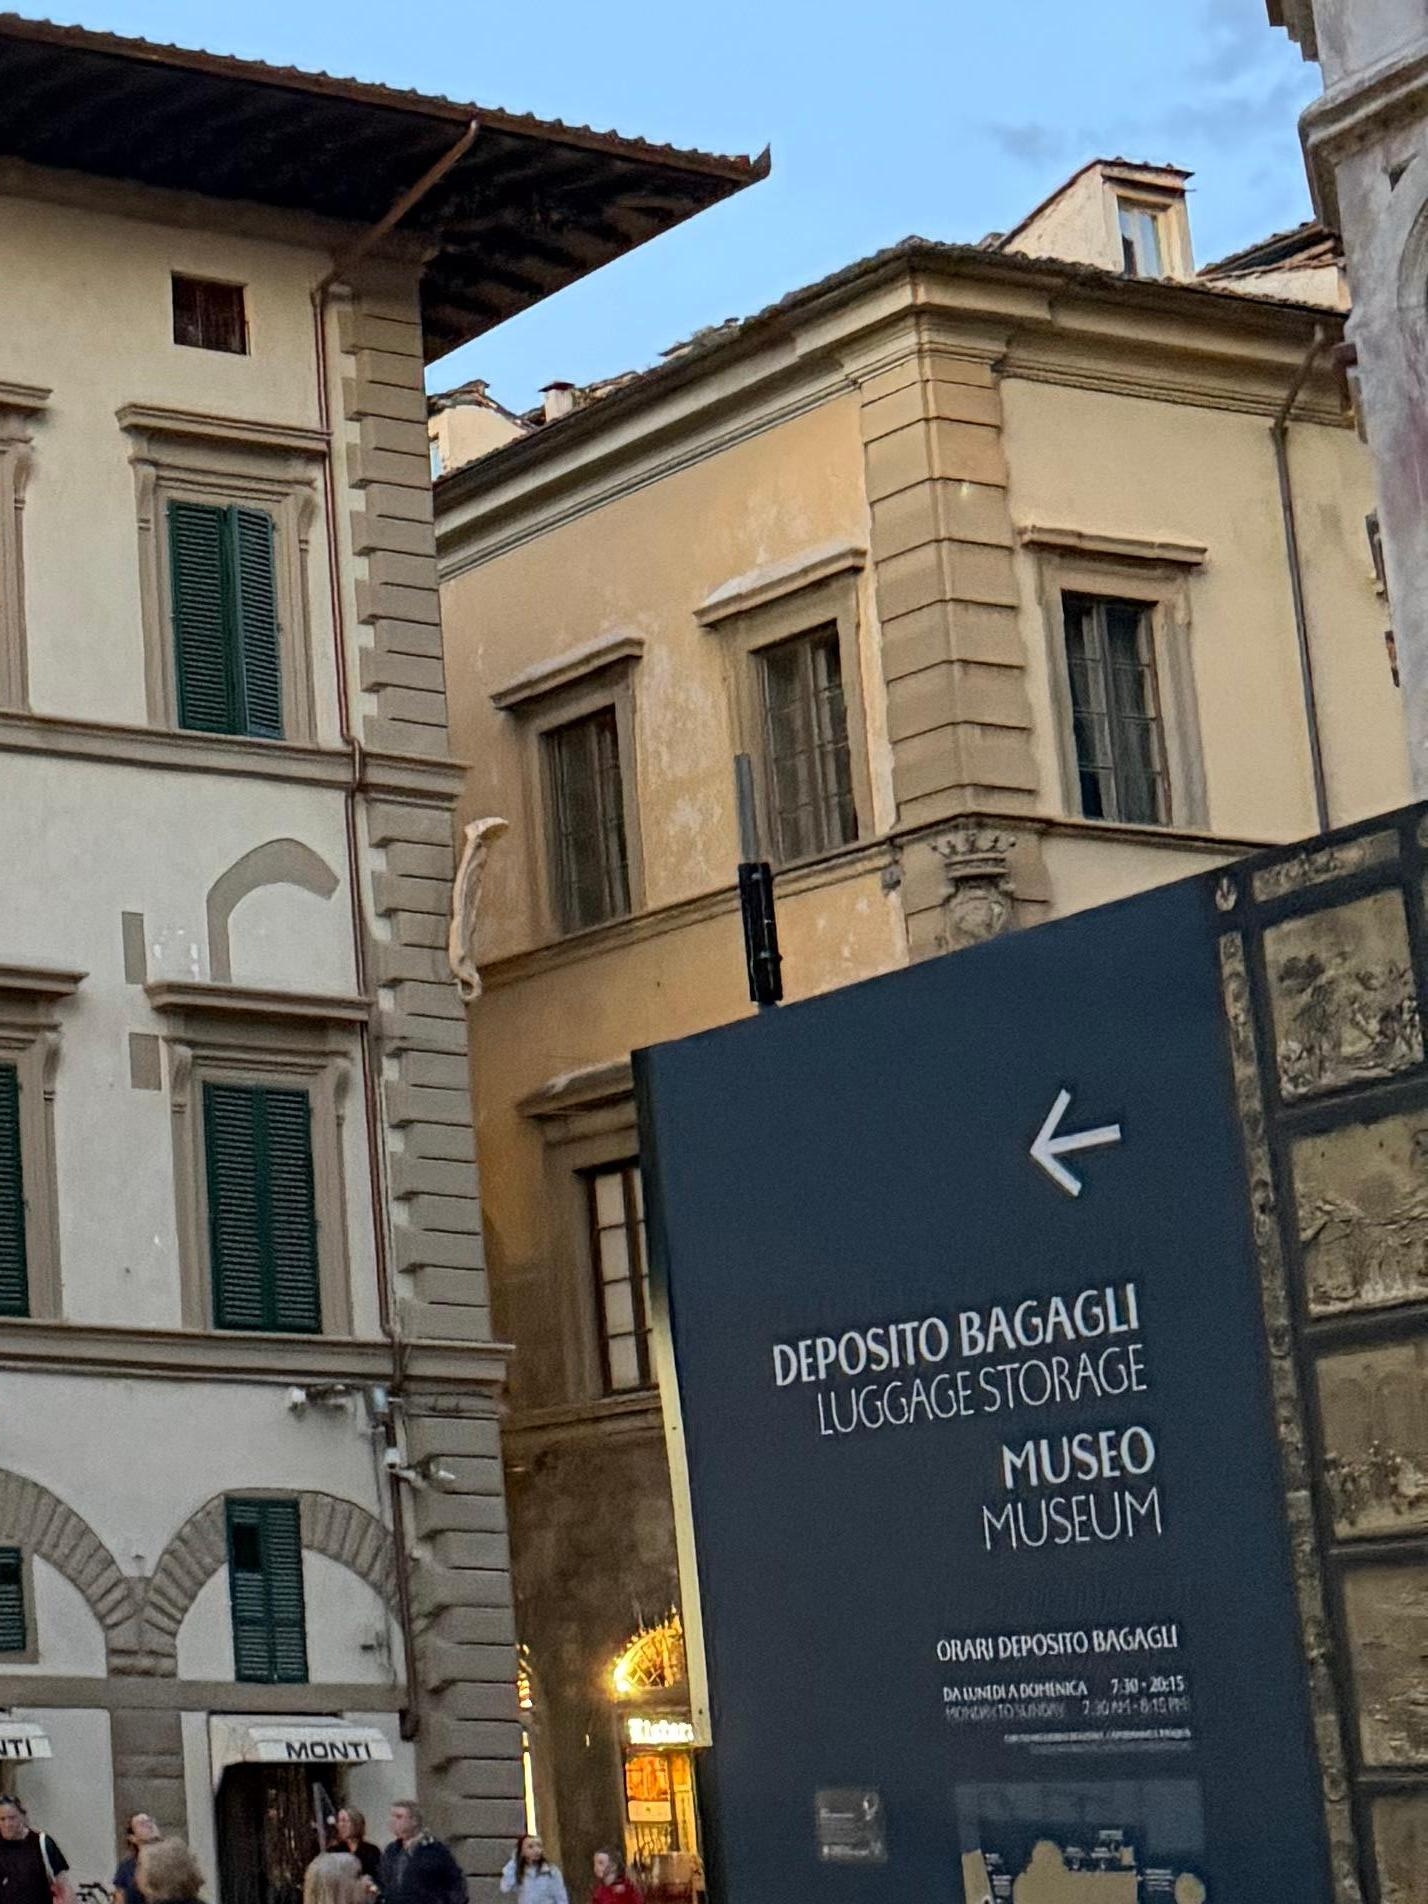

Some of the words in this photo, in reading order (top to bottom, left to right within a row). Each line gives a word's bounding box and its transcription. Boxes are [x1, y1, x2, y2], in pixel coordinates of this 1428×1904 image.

[772, 1316, 950, 1387] DEPOSITO
[958, 1282, 1140, 1357] BAGAGLI
[817, 1370, 975, 1436] LUGGAGE
[978, 1343, 1148, 1413] STORAGE
[1001, 1425, 1156, 1490] MUSEO
[981, 1486, 1163, 1552] MUSEUM
[936, 1637, 994, 1662] ORARI
[997, 1630, 1089, 1659] DEPOSITO
[1092, 1624, 1179, 1652] BAGAGLI
[1019, 1679, 1089, 1699] DOMENICA
[284, 1740, 373, 1760] MONTI
